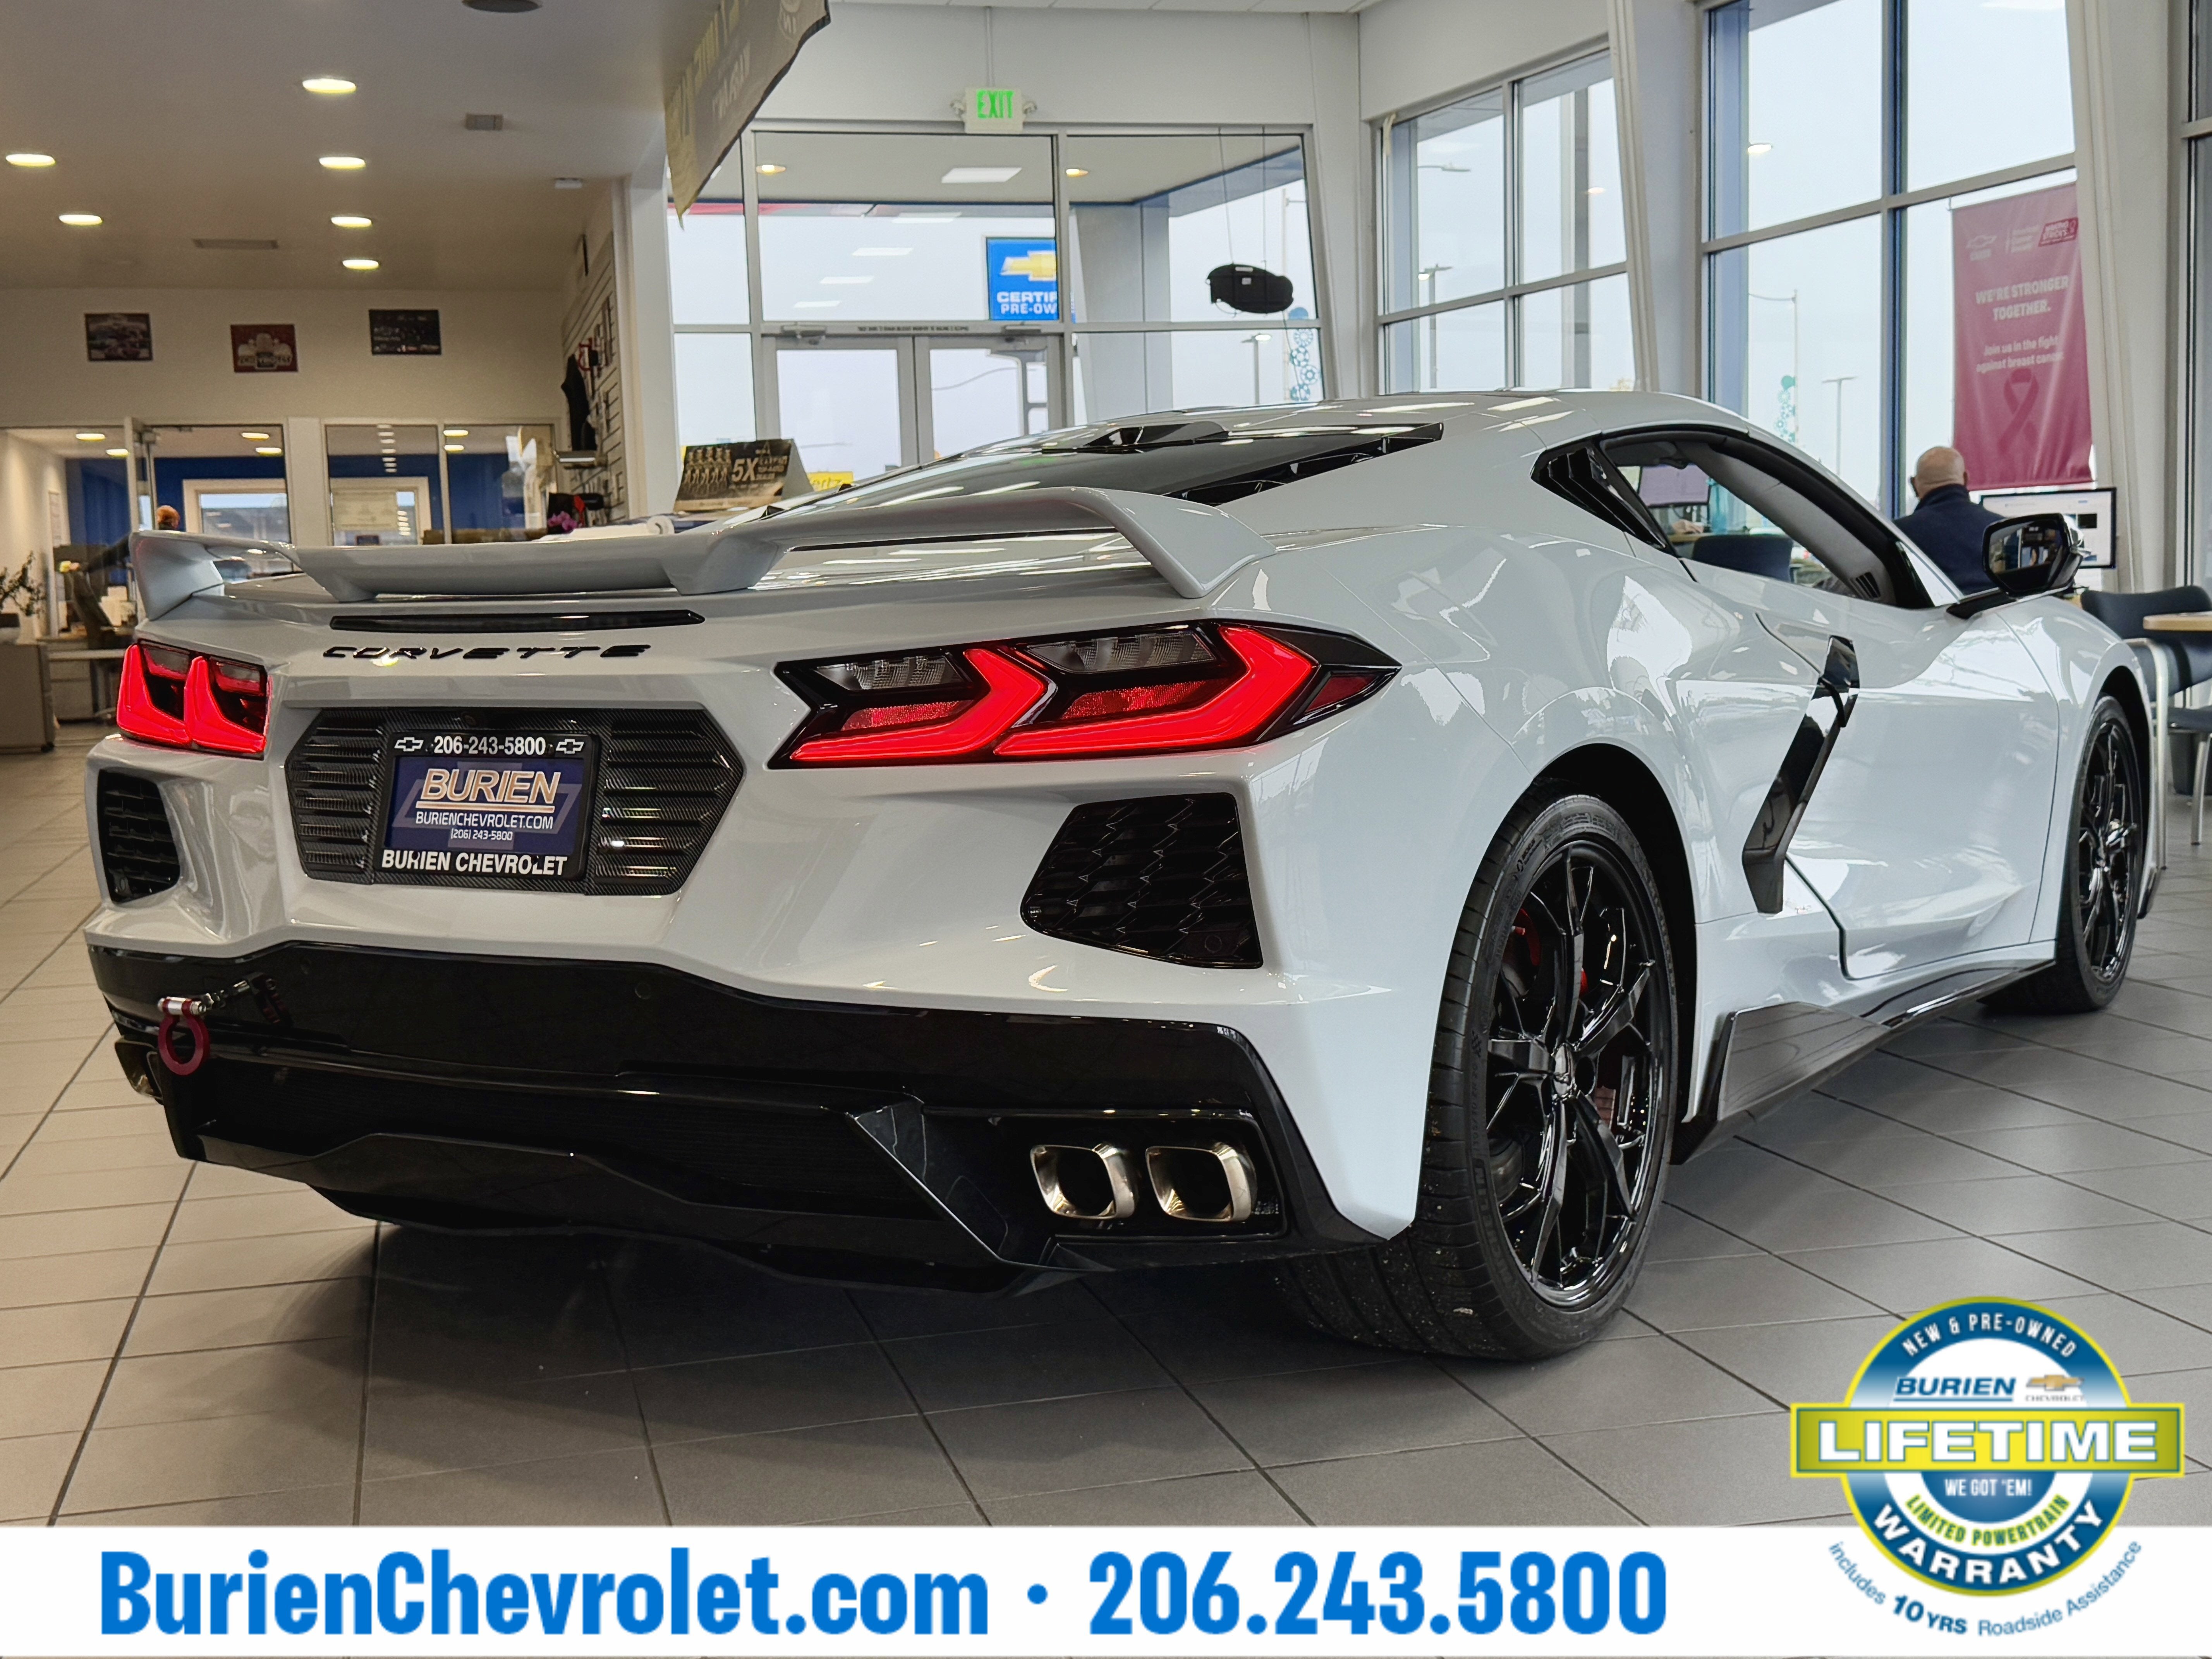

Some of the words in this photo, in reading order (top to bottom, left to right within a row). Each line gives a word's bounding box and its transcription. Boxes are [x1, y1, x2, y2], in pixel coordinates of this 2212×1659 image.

[976, 89, 1014, 118] EXIT
[996, 291, 1058, 303] CERTIF
[1976, 285, 2010, 304] WE'RE
[2011, 275, 2069, 298] STRONGER
[1001, 303, 1057, 314] PRE-OW
[1993, 299, 2051, 321] TOGETHER.
[1984, 345, 2001, 356] Join
[2001, 343, 2013, 353] us
[2013, 340, 2022, 350] in
[2022, 339, 2037, 350] the
[2038, 335, 2059, 349] fight
[1976, 359, 2007, 374] against
[2007, 355, 2035, 368] breast
[731, 457, 759, 482] 5X
[323, 644, 651, 659] CORVETTE
[434, 736, 546, 755] 206-243-5800
[420, 768, 562, 804] BURIEN
[416, 811, 554, 830] BURIENCHEVROLET.COM
[472, 830, 513, 841] 243-5800
[381, 849, 451, 871] BURIEN
[455, 852, 568, 876] CHEVROLET
